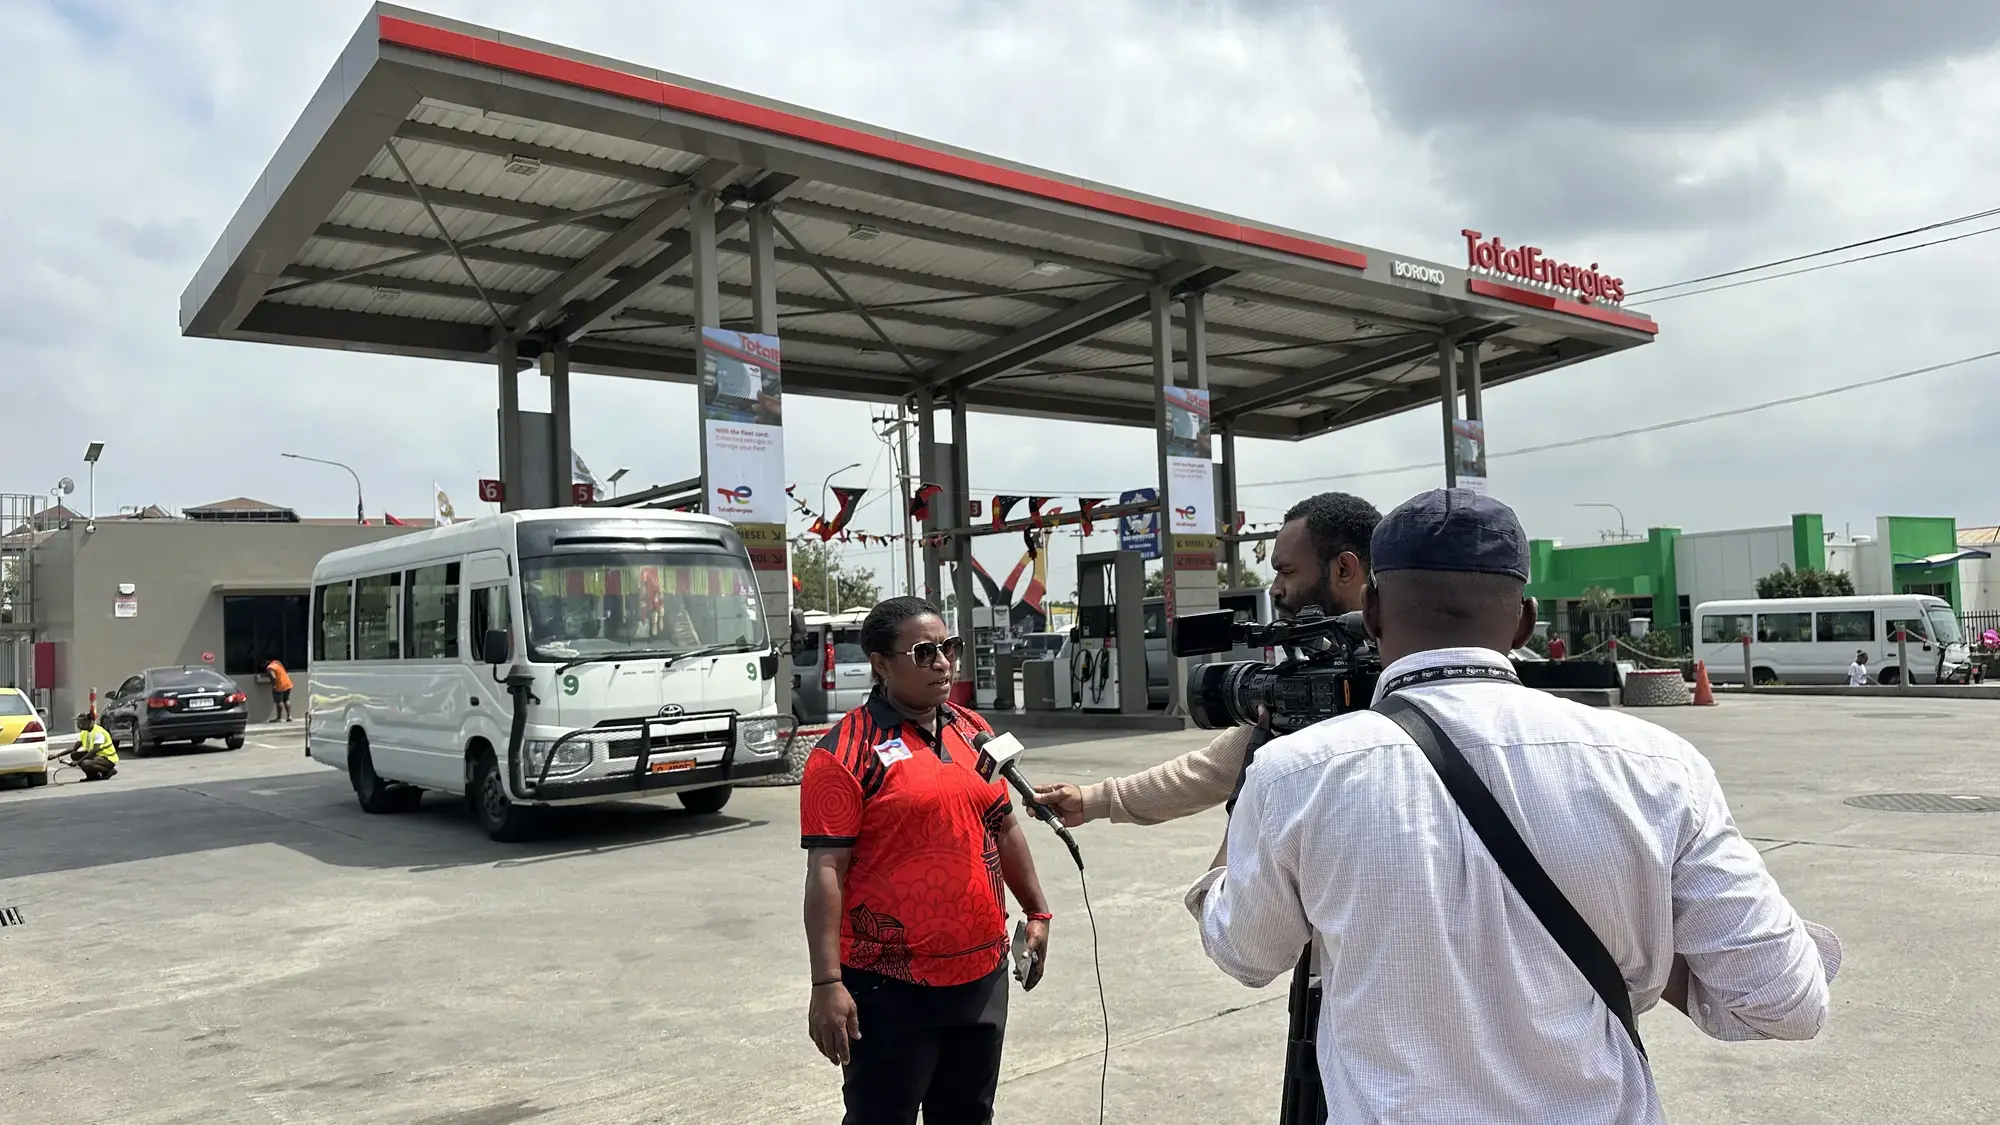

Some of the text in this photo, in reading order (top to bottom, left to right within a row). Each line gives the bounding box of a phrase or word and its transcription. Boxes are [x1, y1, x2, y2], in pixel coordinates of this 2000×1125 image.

[1393, 260, 1445, 285] BOROKO
[1461, 229, 1624, 304] TotalEnergies
[486, 483, 497, 498] 6
[578, 487, 589, 501] 5
[717, 506, 753, 515] TotalEnergies
[971, 503, 978, 515] 3
[746, 662, 757, 681] 9
[563, 675, 579, 695] 9
